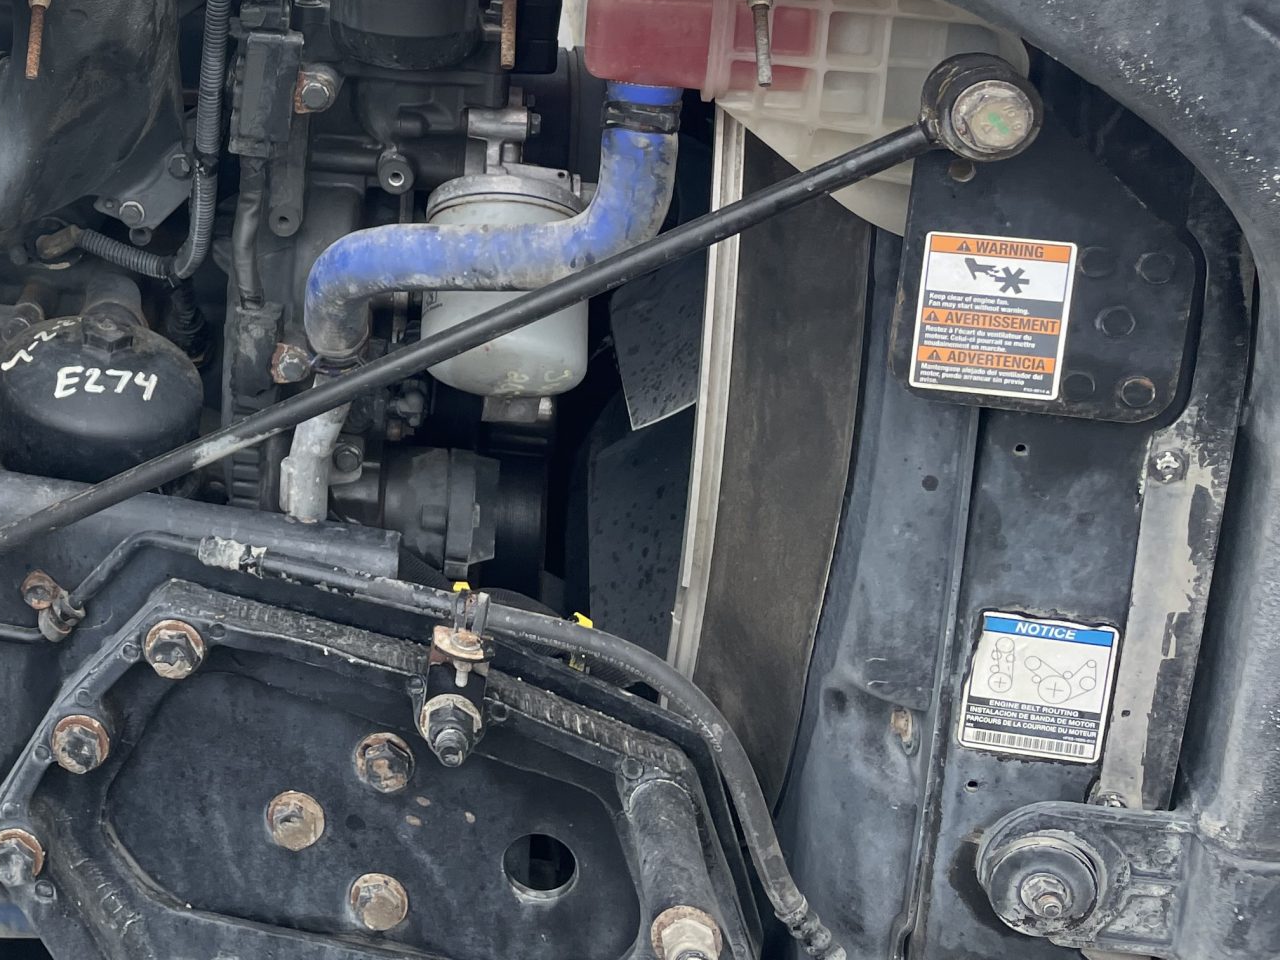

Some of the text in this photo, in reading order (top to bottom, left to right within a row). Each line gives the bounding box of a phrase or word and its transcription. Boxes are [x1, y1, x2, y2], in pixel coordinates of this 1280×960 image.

[976, 241, 1044, 258] WARNING
[929, 293, 946, 301] Keep
[973, 297, 995, 306] engine
[975, 304, 1000, 312] without
[1001, 307, 1030, 315] warning.
[945, 312, 1058, 333] AVERTISSEMENT
[925, 333, 949, 341] moteur.
[951, 334, 976, 343] Celui-ci
[977, 337, 1003, 346] pourrait
[1014, 340, 1035, 349] mettre
[926, 325, 947, 333] Restez
[987, 330, 1022, 339] ventilateur
[924, 340, 970, 349] soudainement
[981, 344, 1007, 352] marche.
[947, 351, 1045, 370] ADVERTENCIA
[53, 365, 158, 401] E274
[1015, 622, 1077, 640] NOTICE
[970, 706, 1096, 728] INSTALACION DE BANDA DE MOTOR
[989, 700, 1079, 718] ENGINE BELT ROUTING
[966, 715, 1001, 725] PARCOURS
[1023, 722, 1057, 733] COURROIE
[1058, 726, 1067, 734] DU
[1069, 728, 1097, 738] MOTEUR
